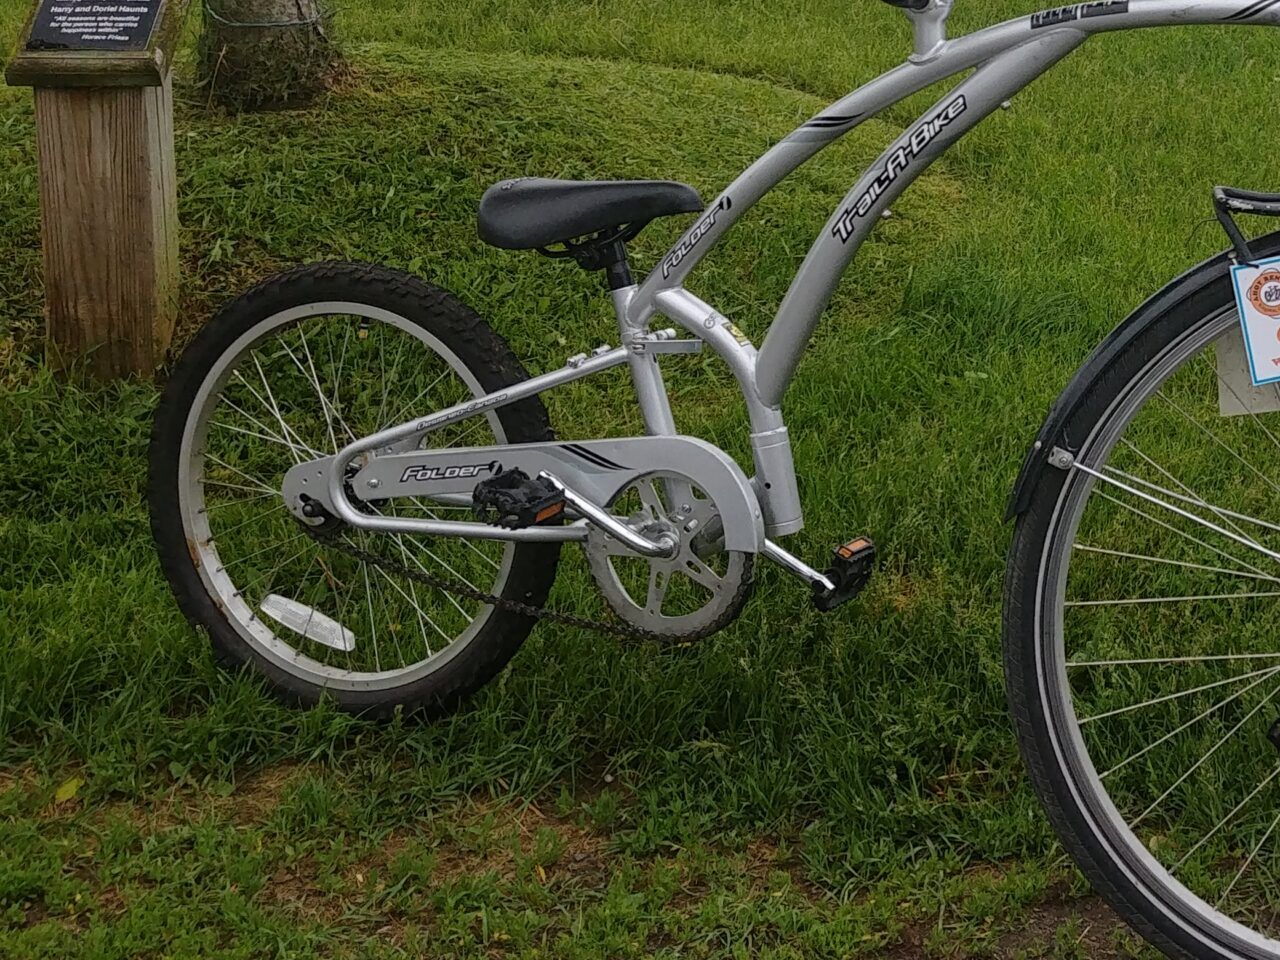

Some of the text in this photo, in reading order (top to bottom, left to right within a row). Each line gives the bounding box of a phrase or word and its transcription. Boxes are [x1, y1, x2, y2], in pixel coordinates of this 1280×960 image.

[50, 6, 74, 14] Harry
[118, 5, 149, 13] Haunts
[1252, 280, 1262, 302] AHOY
